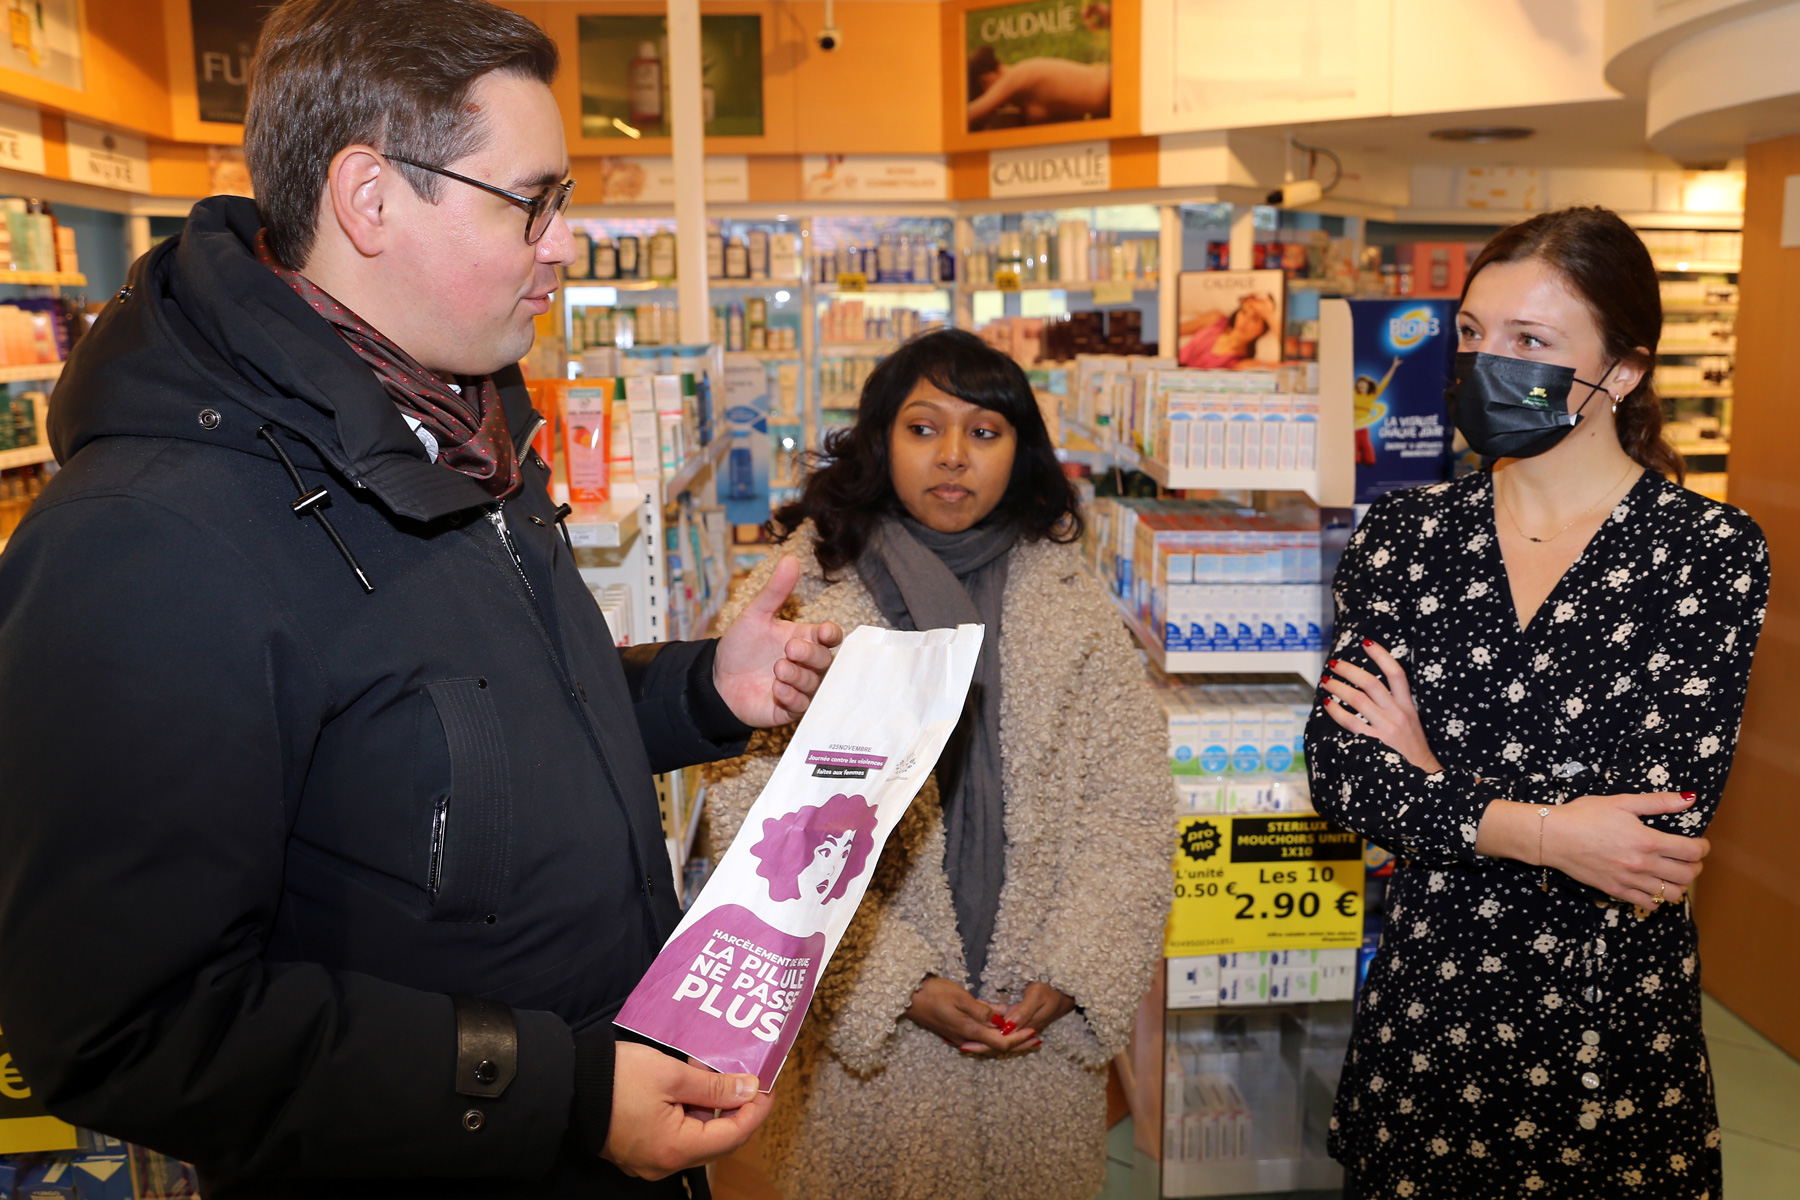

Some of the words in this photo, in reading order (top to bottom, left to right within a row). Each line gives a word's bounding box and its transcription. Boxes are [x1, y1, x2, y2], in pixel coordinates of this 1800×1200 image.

[203, 51, 248, 86] FU
[828, 744, 872, 752] #25NOVEMBRE
[808, 754, 830, 762] Journée
[858, 758, 884, 767] violences
[844, 768, 865, 776] femmes
[1267, 821, 1328, 833] STERILUX
[1187, 828, 1214, 842] pro
[1238, 834, 1314, 846] MOUCHOIRS
[1319, 832, 1357, 843] UNITE
[1190, 840, 1214, 852] mo
[1281, 847, 1313, 858] 1X10
[1176, 868, 1224, 879] L'unité
[1259, 868, 1297, 884] Les
[1308, 867, 1334, 882] 10
[1174, 883, 1218, 898] 0.50
[1226, 882, 1238, 896] €
[1235, 892, 1320, 919] 2.90
[1335, 891, 1358, 917] €
[713, 929, 791, 967] HARCÈLEMENT
[701, 939, 735, 965] LA
[740, 954, 806, 989] PILULE
[690, 954, 732, 983] NE
[731, 972, 800, 1012] PASSE
[672, 973, 786, 1042] PLUS
[0, 1053, 32, 1099] €
